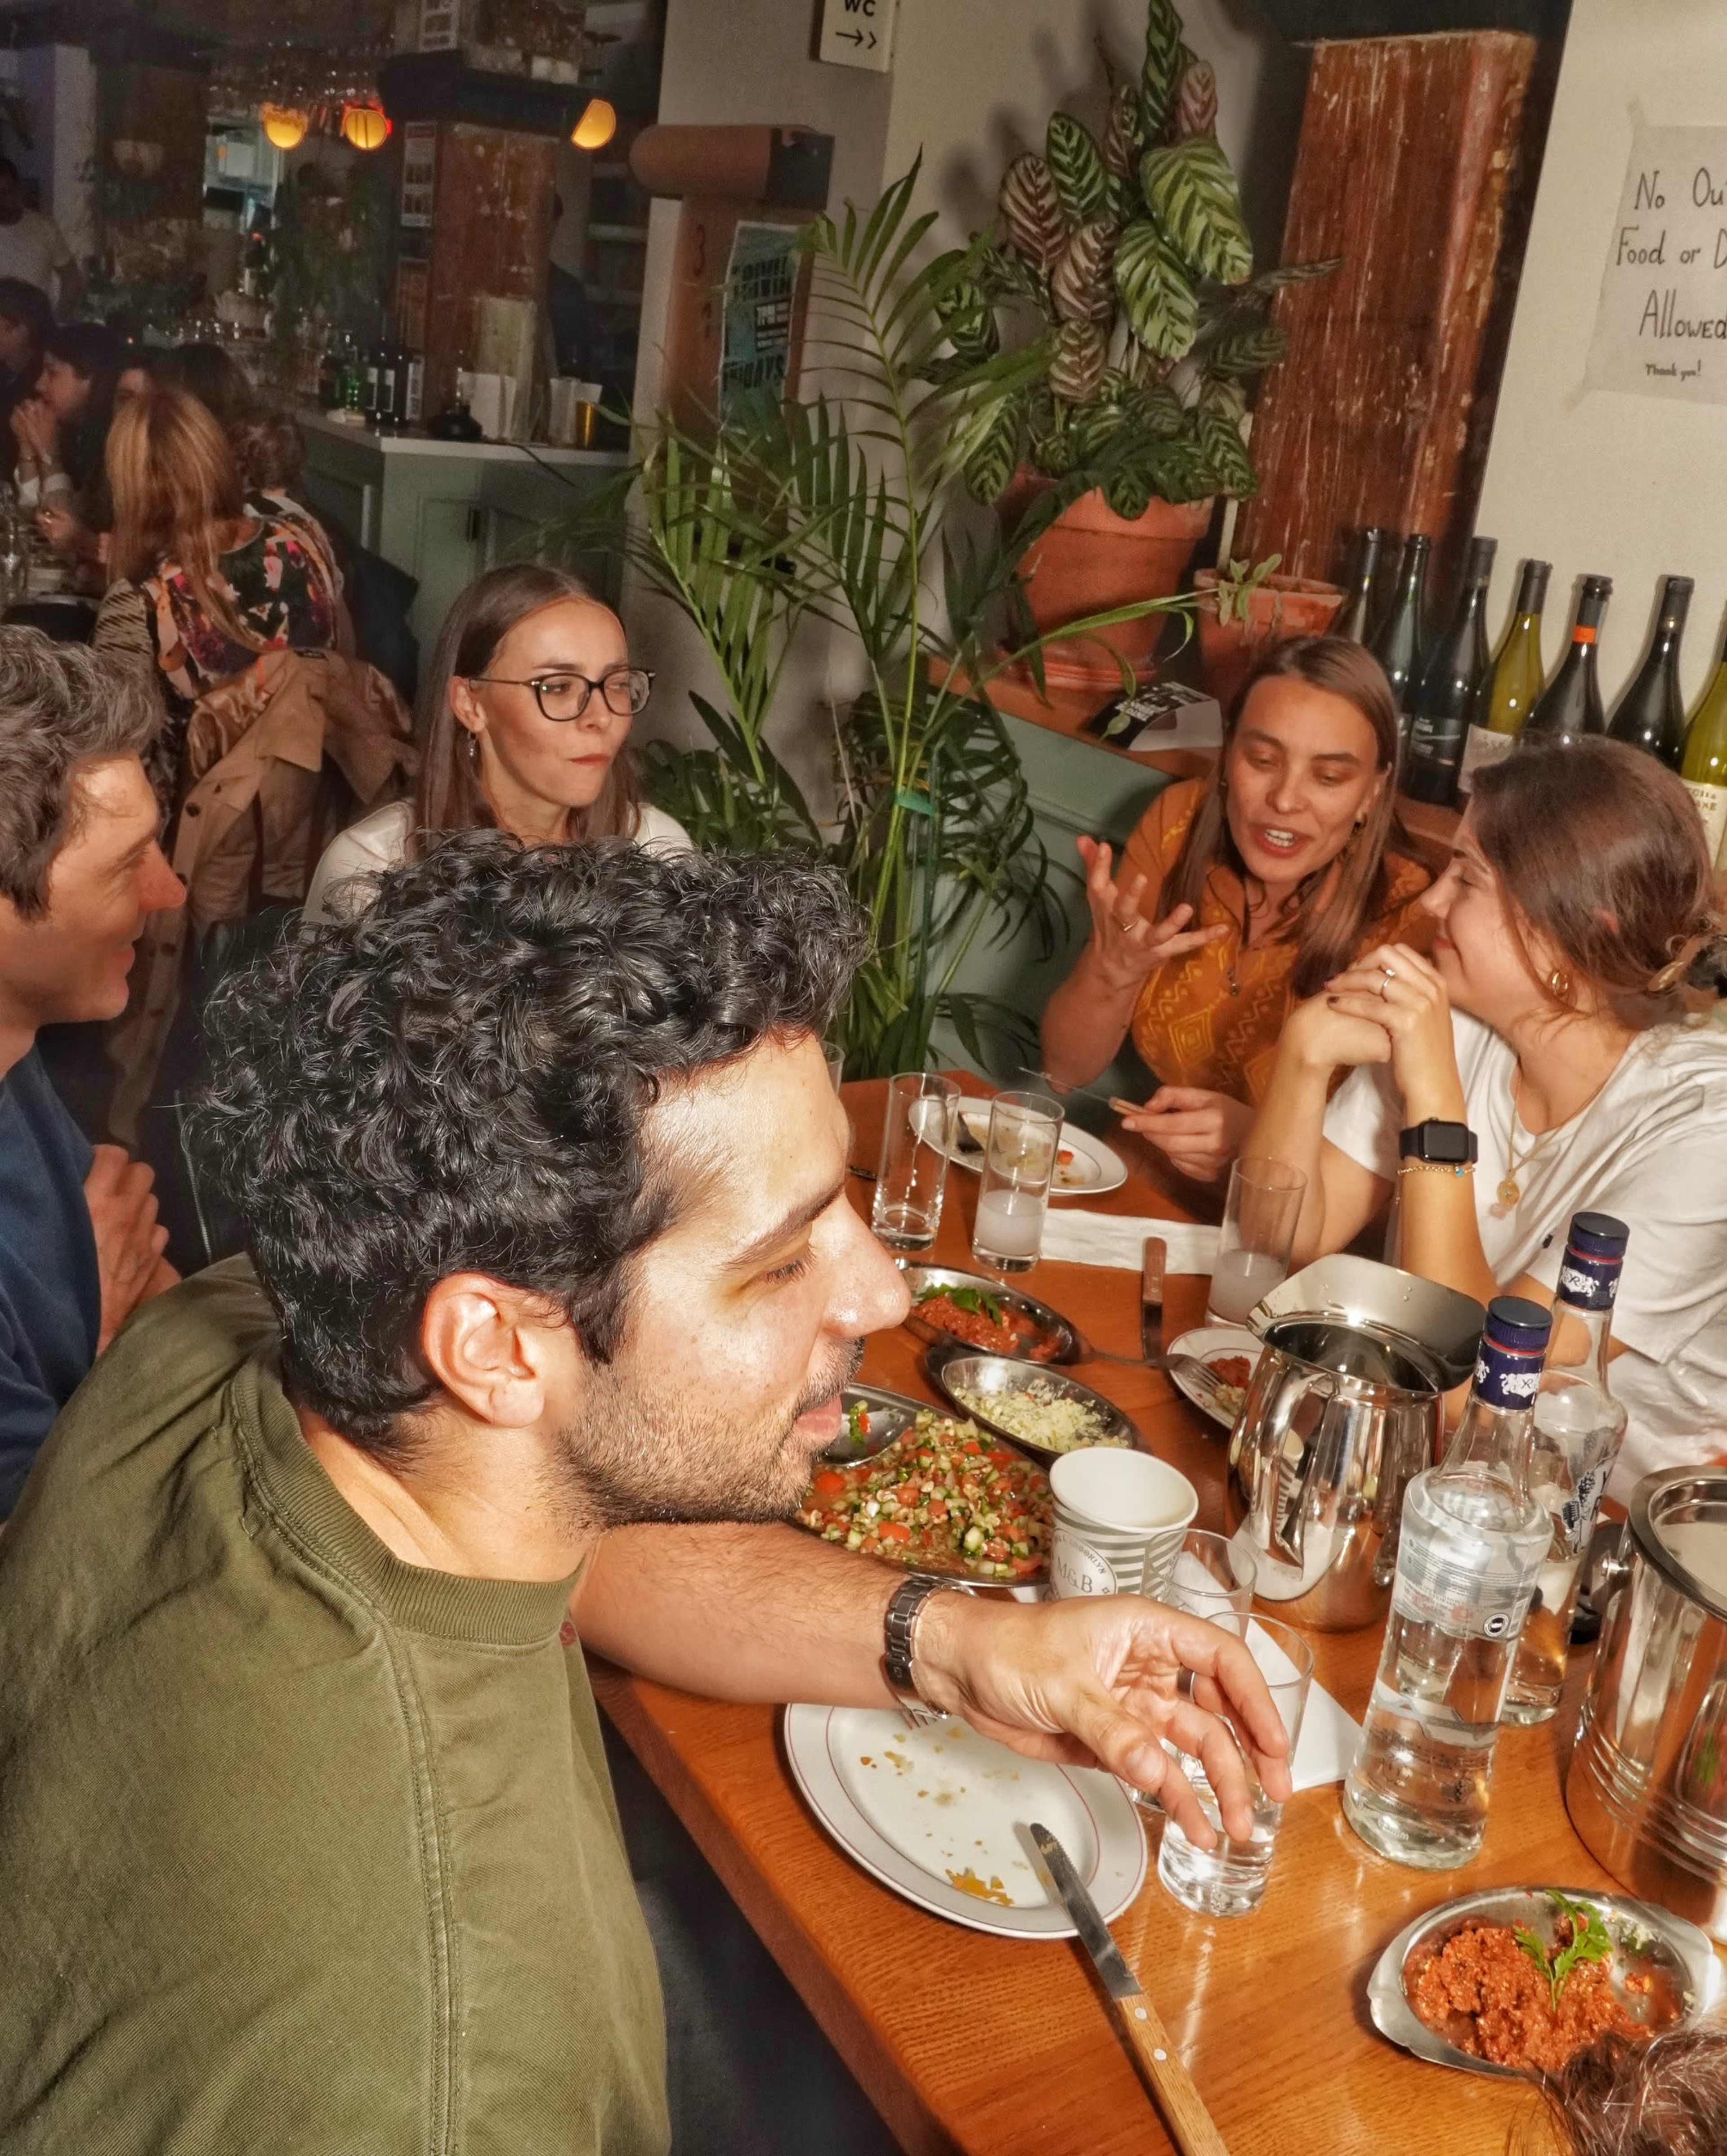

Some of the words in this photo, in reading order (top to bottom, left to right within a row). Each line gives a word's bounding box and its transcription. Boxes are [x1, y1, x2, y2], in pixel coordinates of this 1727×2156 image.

[844, 0, 876, 16] WC
[1634, 170, 1665, 210] No
[1692, 167, 1727, 208] Ou
[1616, 225, 1666, 266] Food
[1679, 248, 1701, 264] or
